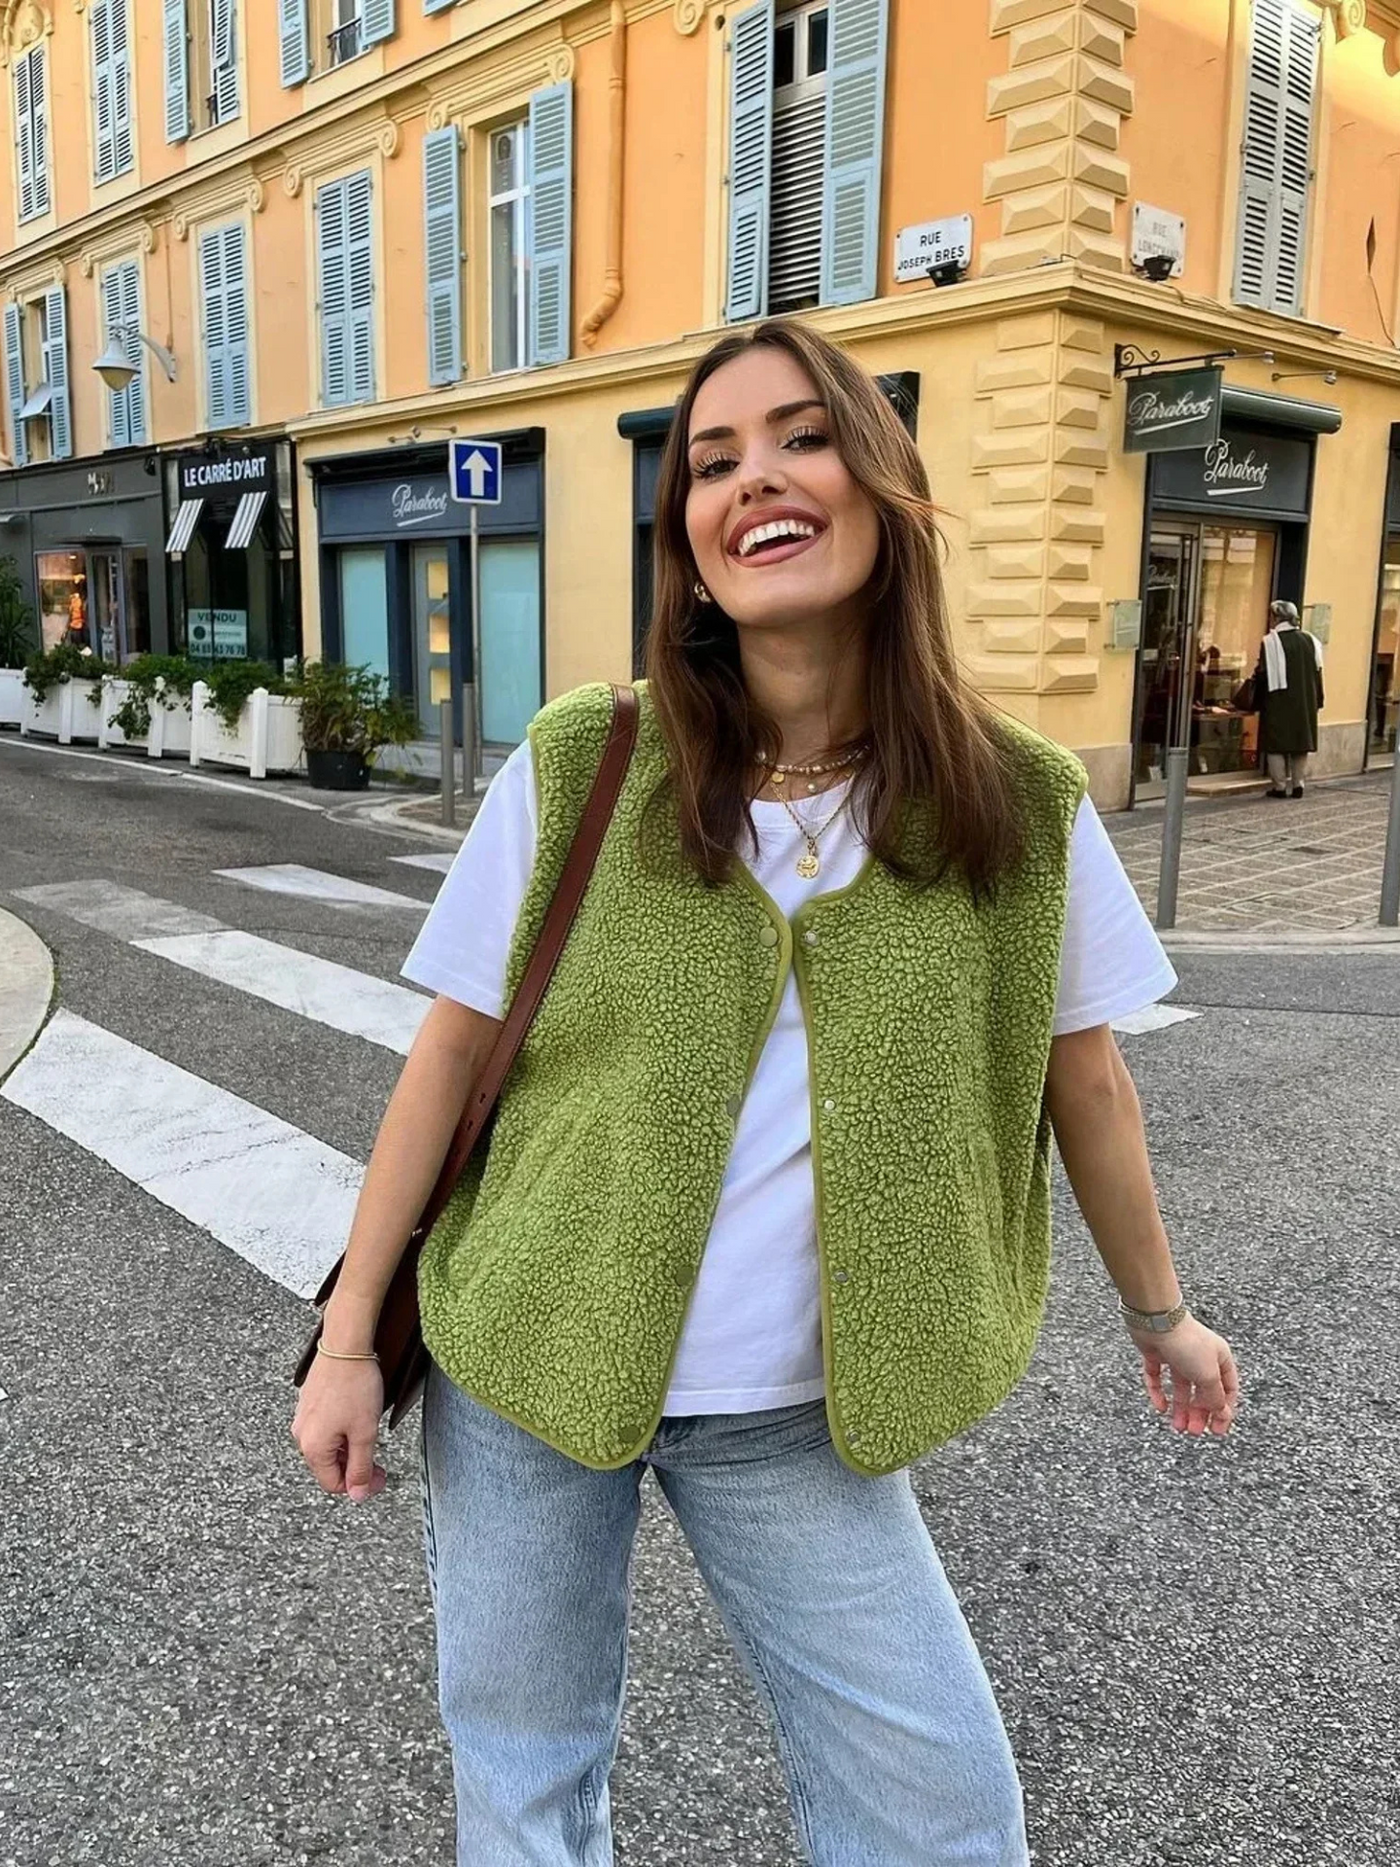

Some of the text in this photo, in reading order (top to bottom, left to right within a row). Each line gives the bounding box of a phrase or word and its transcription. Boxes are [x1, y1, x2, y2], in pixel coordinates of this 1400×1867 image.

[898, 245, 965, 270] JOSEPH BRES
[919, 231, 942, 247] RUE
[1128, 390, 1215, 435] Paraboot
[184, 456, 267, 487] LE CARRÉ D'ART
[1204, 438, 1270, 496] Paraboot
[391, 484, 448, 527] Paraboot
